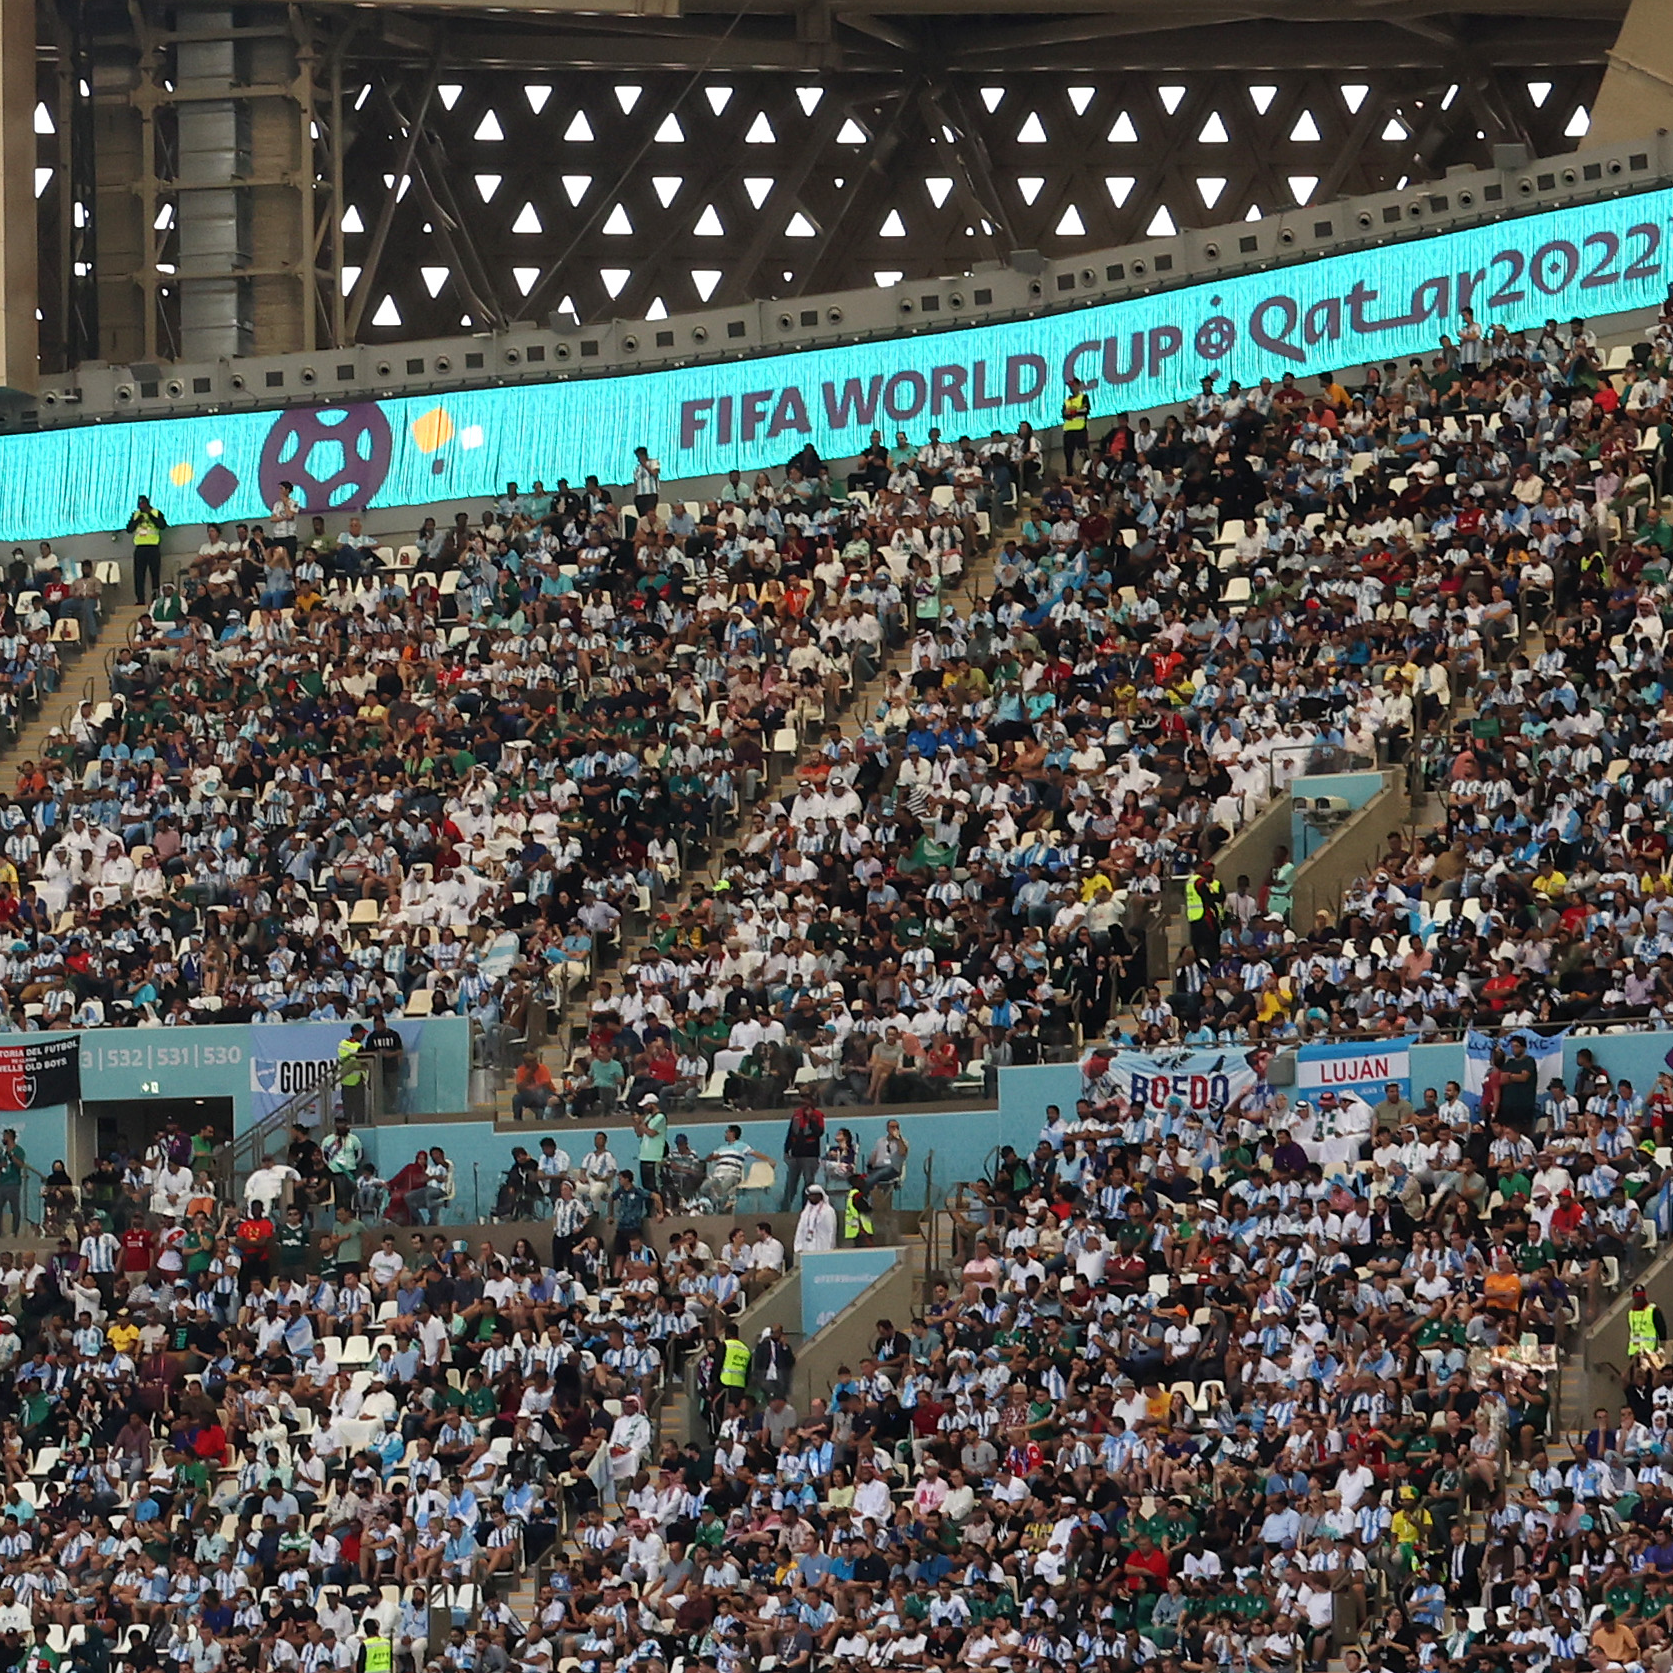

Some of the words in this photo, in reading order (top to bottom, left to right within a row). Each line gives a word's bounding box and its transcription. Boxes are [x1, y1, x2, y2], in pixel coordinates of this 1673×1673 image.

[680, 387, 813, 449] FIFA
[821, 354, 1048, 429] WORLD
[1062, 325, 1183, 387] CUP
[26, 1047, 42, 1056] DEL
[44, 1040, 78, 1054] FUTBOL
[107, 1047, 143, 1067] 532
[157, 1046, 189, 1066] 531
[204, 1045, 241, 1065] 530
[25, 1062, 42, 1071] OLD
[44, 1057, 67, 1069] BOYS
[1321, 1054, 1389, 1083] LUJÁN
